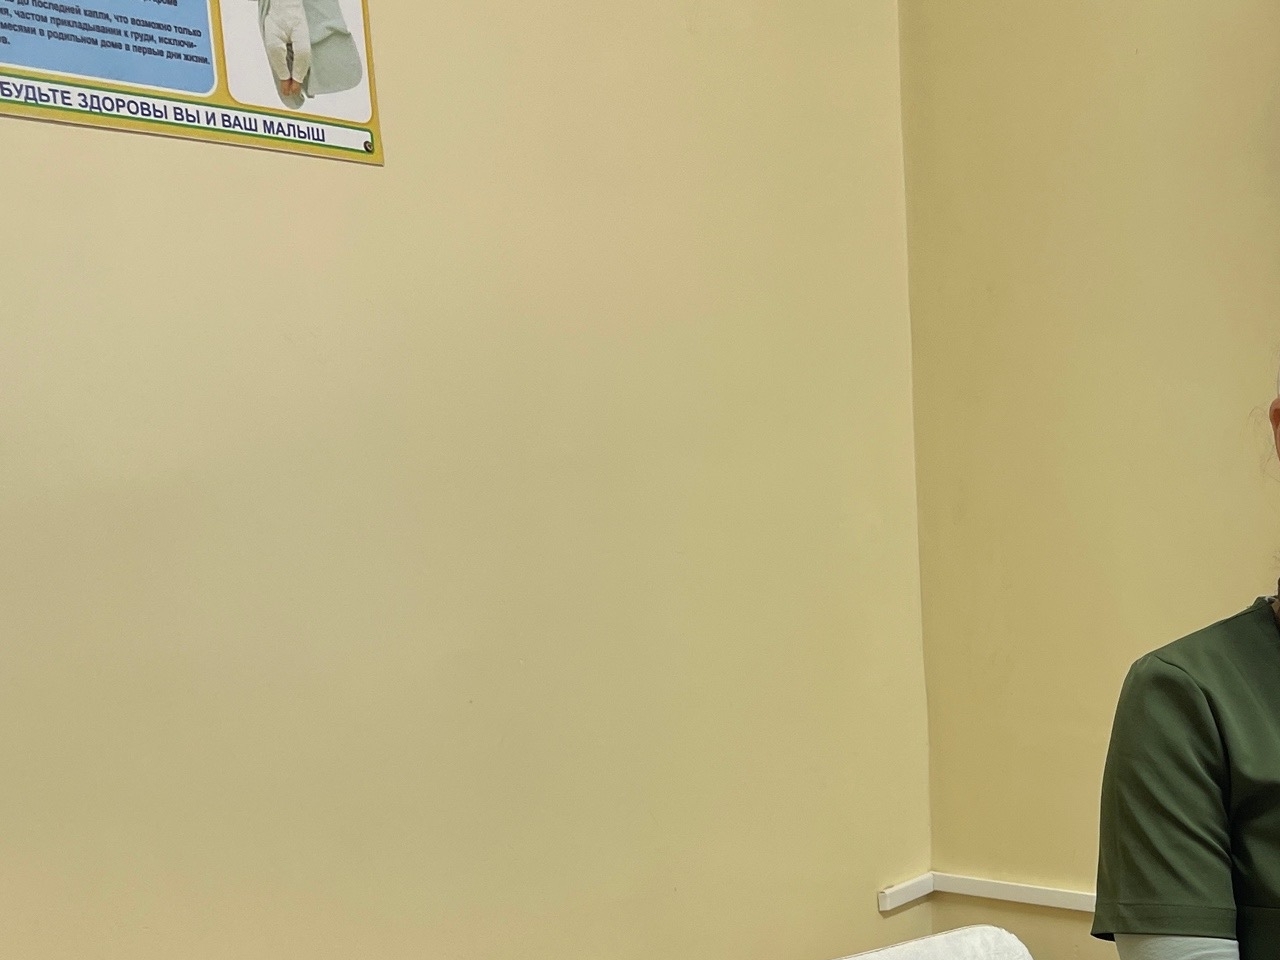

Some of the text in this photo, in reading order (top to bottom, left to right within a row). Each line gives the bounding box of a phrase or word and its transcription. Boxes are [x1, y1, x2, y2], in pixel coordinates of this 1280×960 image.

[14, 9, 48, 23] частом
[50, 16, 122, 37] прикладывании
[123, 30, 129, 38] к
[130, 30, 157, 45] груди,
[158, 35, 197, 49] исключи-
[31, 0, 82, 15] последней
[83, 8, 112, 22] капли,
[113, 14, 129, 24] что
[130, 17, 172, 32] возможно
[173, 25, 202, 37] только
[0, 21, 37, 35] месями
[46, 29, 99, 46] родильном
[132, 44, 164, 57] первые
[166, 50, 181, 60] дни
[183, 53, 210, 65] жизни.
[0, 81, 326, 143] БУДЬТЕ ЗДОРОВЫ ВЫ И ВАШ МАЛЫШ
